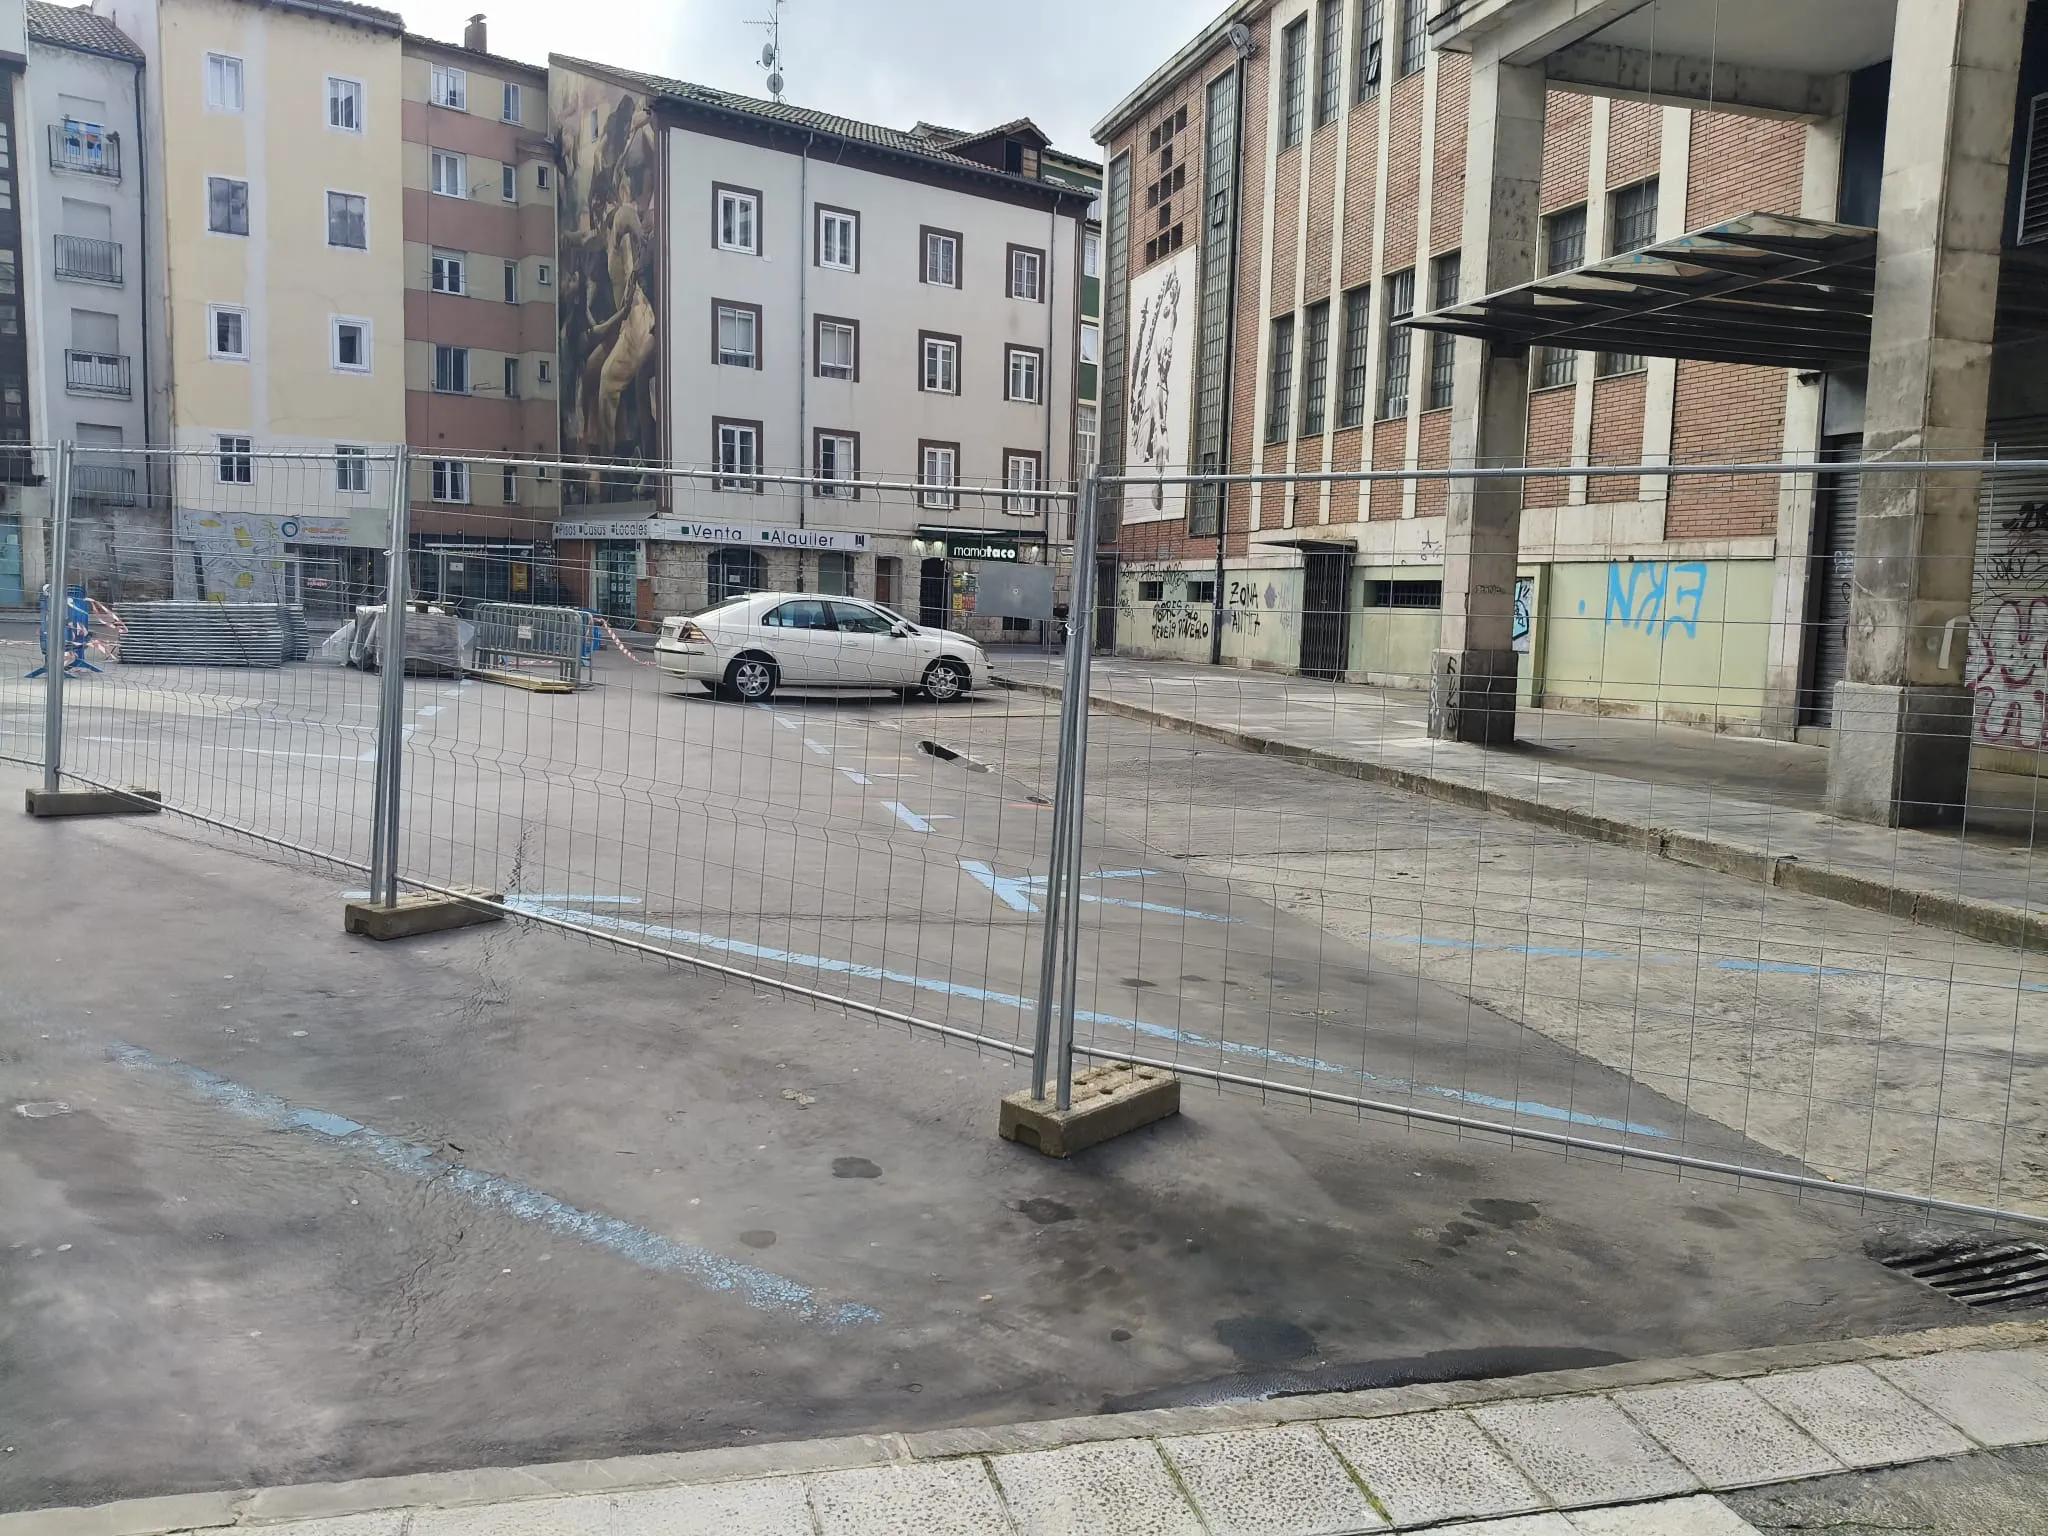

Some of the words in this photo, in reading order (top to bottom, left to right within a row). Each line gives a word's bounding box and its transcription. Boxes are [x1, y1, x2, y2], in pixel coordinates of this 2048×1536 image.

[615, 522, 648, 536] Locales
[691, 524, 742, 541] Venta
[771, 529, 835, 547] Alquiler
[953, 545, 1016, 559] mamataco
[1229, 581, 1258, 609] ZONA
